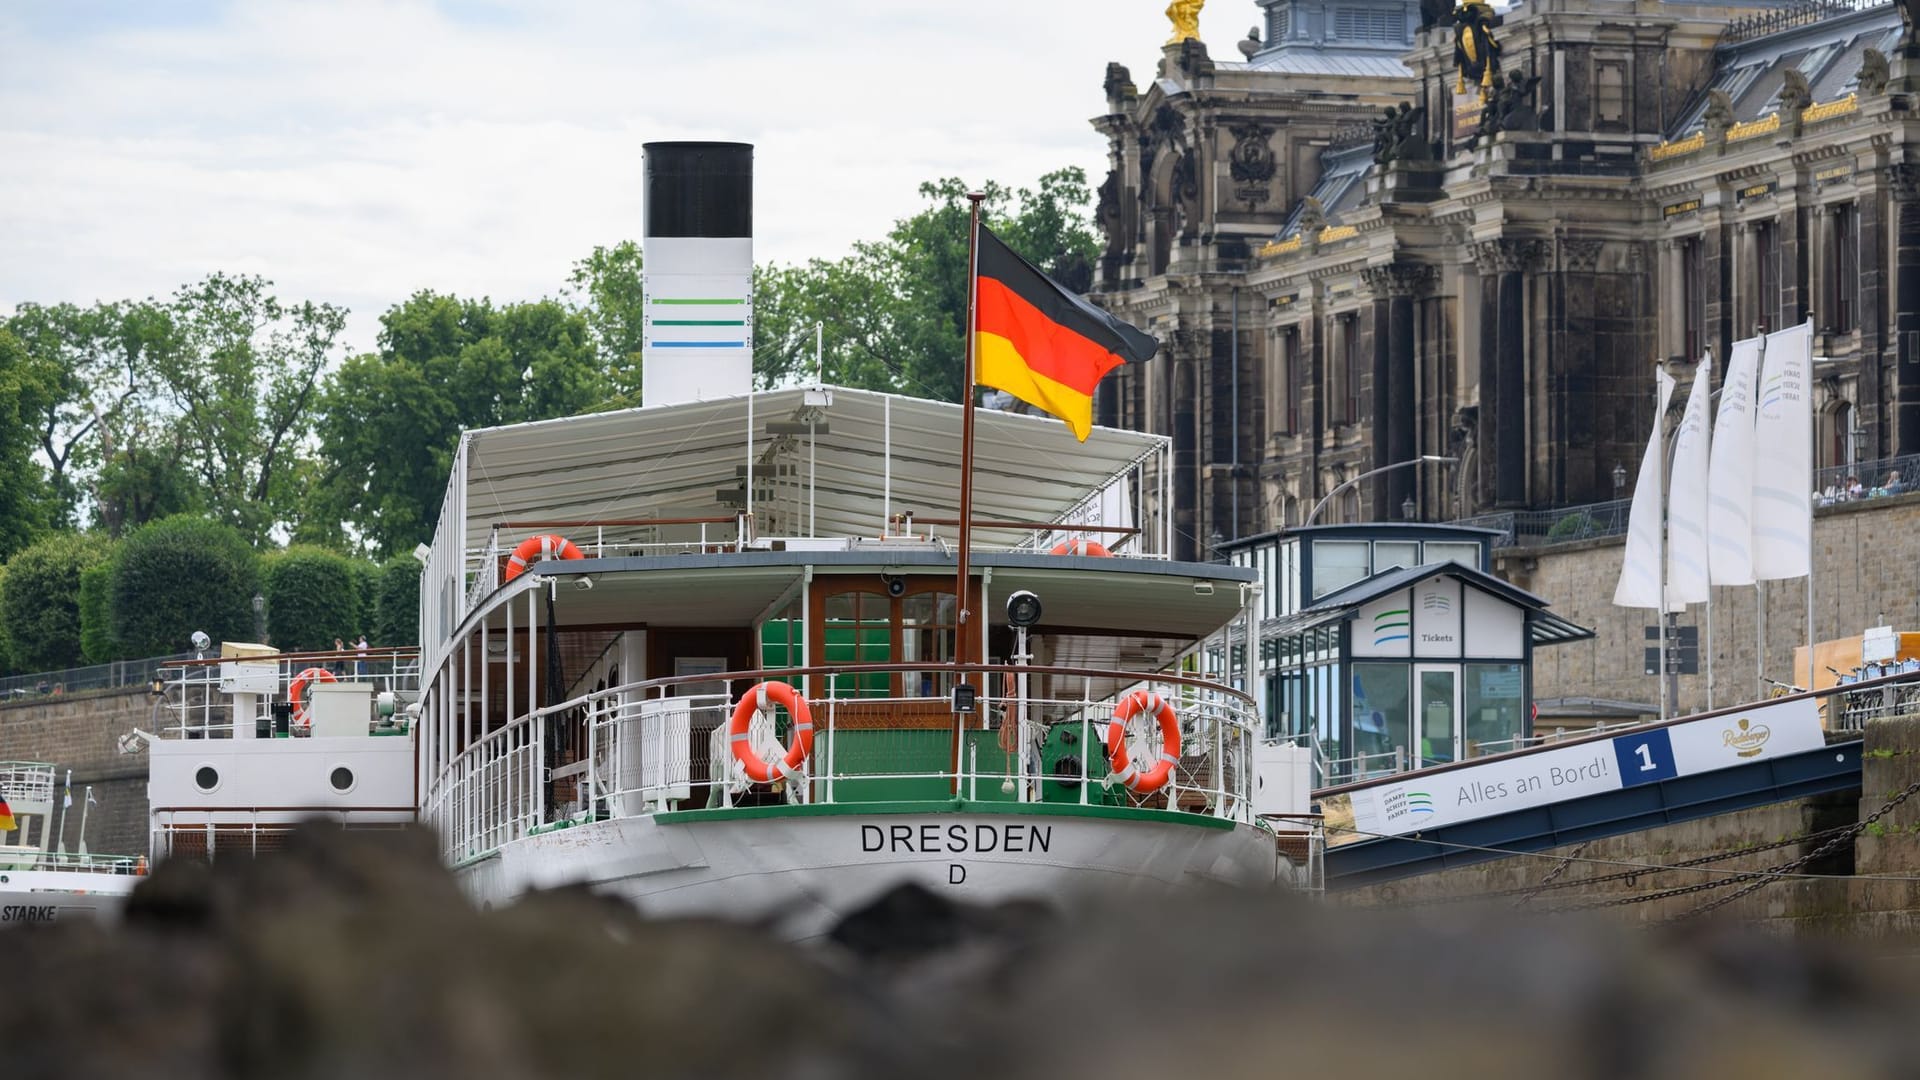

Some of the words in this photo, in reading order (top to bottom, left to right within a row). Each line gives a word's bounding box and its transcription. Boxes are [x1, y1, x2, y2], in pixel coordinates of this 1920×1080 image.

[1421, 634, 1453, 642] Tickets
[1457, 782, 1508, 806] Alles
[1516, 775, 1541, 794] an
[1550, 757, 1609, 786] Bord!
[1634, 743, 1657, 772] 1
[861, 824, 1052, 853] DRESDEN
[949, 864, 966, 885] D
[2, 905, 57, 921] STARKE
